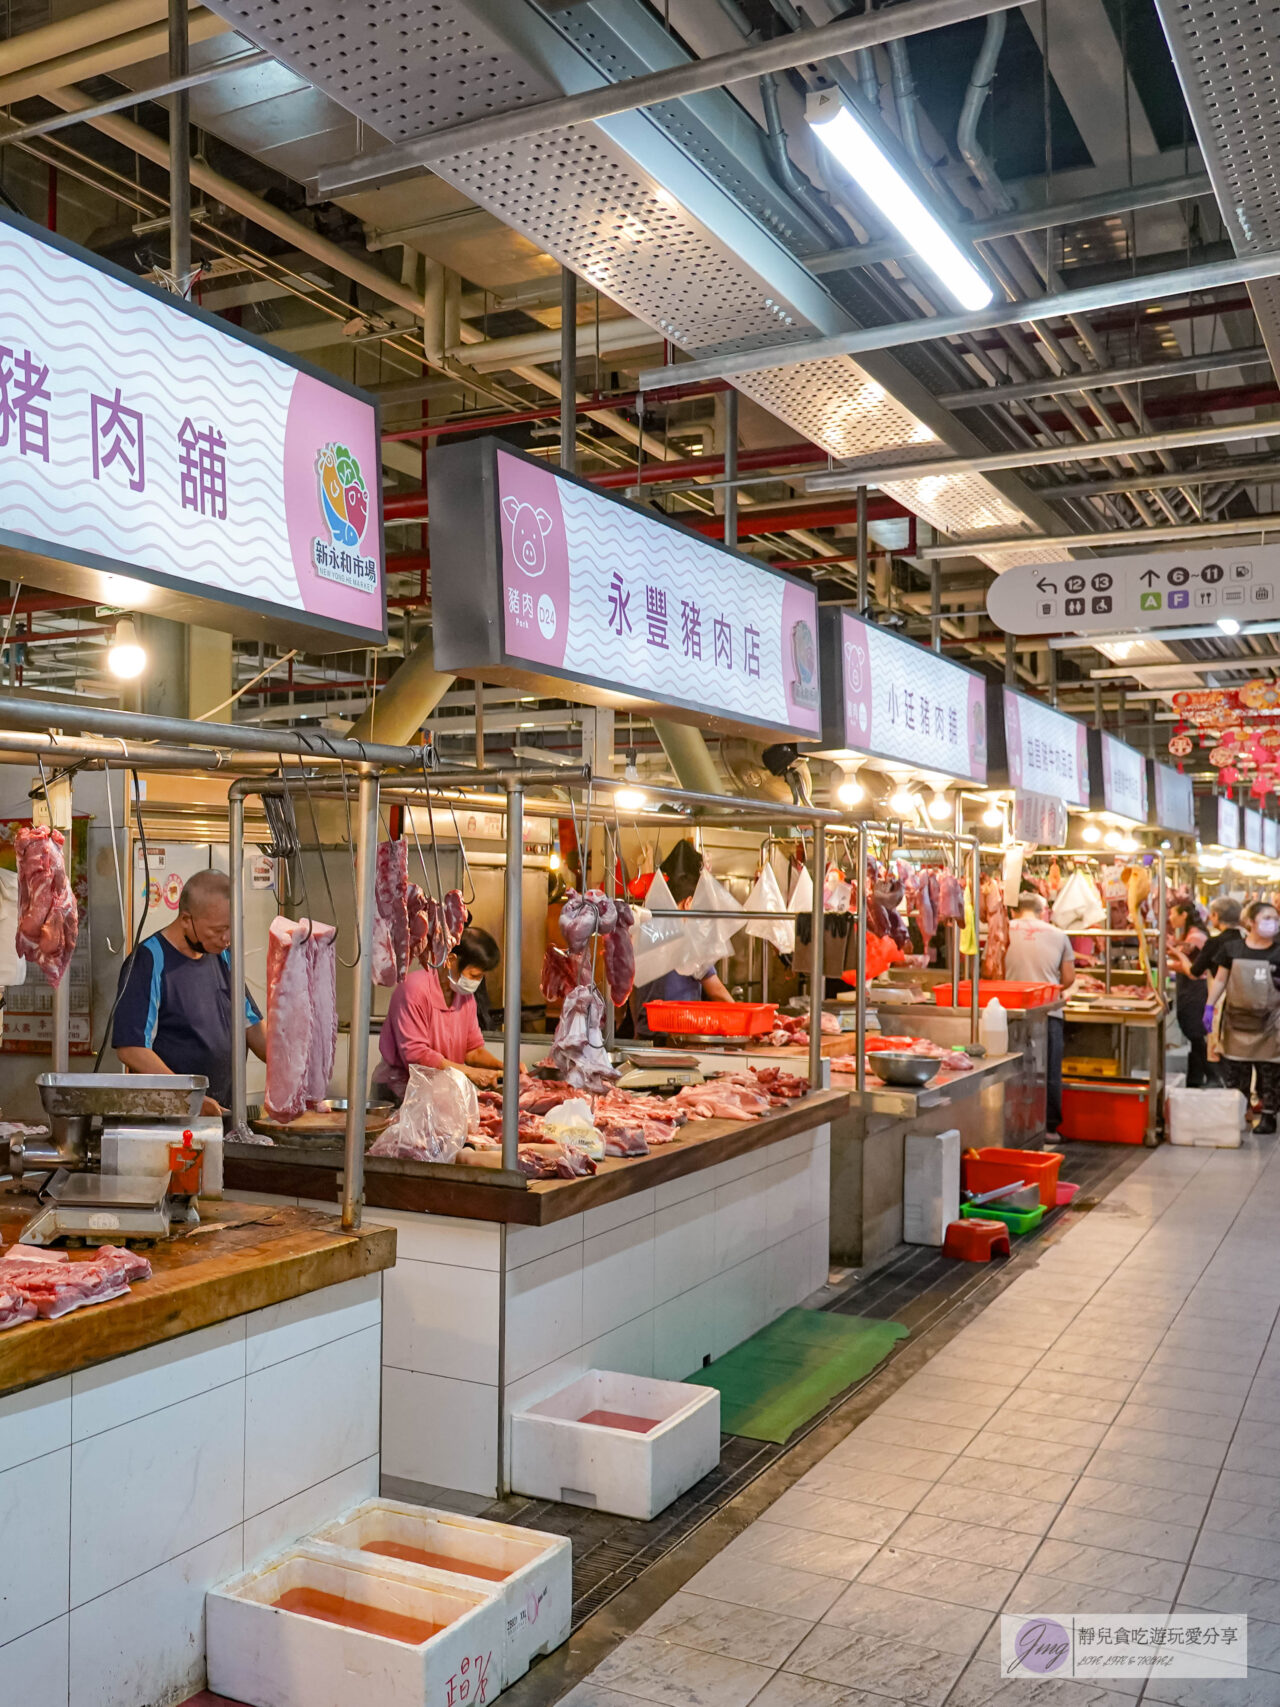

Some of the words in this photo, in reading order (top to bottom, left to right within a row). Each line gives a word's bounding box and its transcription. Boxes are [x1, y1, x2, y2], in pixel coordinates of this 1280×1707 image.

[316, 540, 376, 583] 新永和市場
[1067, 579, 1083, 590] 12
[1094, 576, 1110, 588] 13
[507, 587, 534, 619] 豬肉
[1144, 595, 1158, 608] A
[1173, 594, 1183, 606] F
[539, 606, 555, 625] D24
[608, 571, 762, 680] 永豐豬肉店
